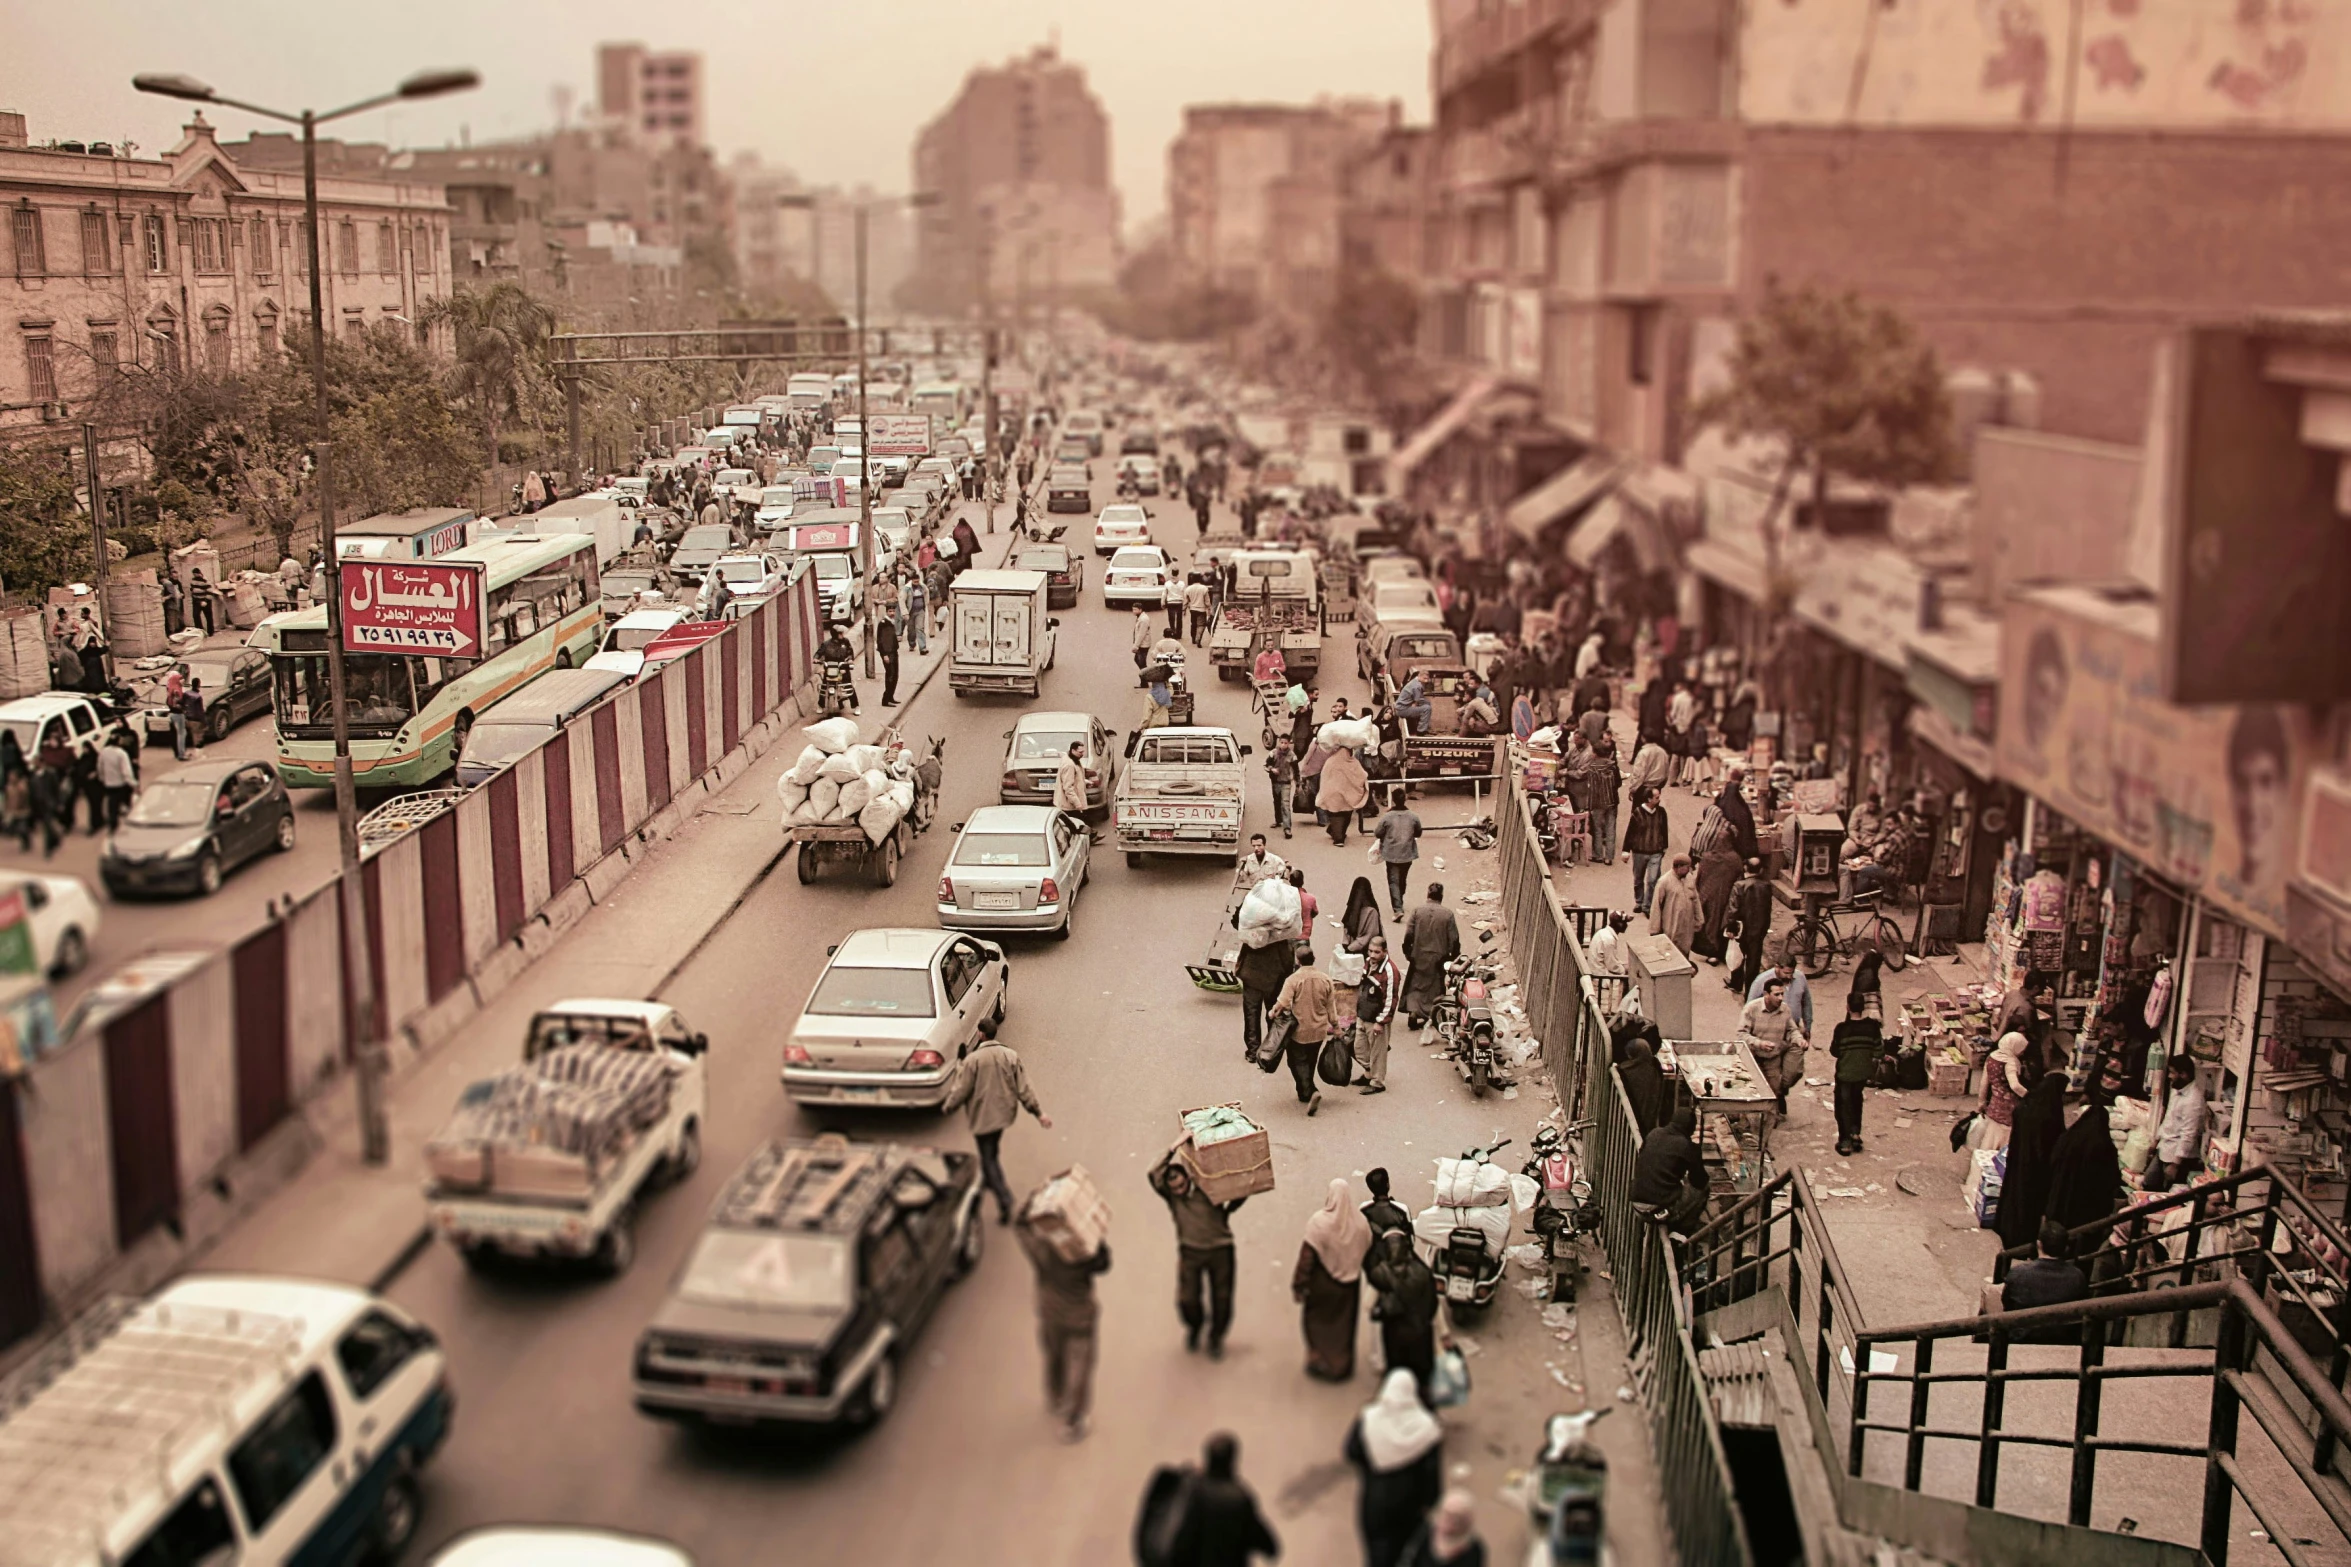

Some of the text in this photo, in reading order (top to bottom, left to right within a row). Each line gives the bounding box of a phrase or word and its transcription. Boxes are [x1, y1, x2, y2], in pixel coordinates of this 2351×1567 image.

[430, 524, 462, 556] LORD
[392, 569, 430, 584] شركة
[350, 566, 471, 611] العسال
[414, 610, 455, 626] للملابس
[1421, 750, 1479, 758] SUZUKI
[1139, 807, 1216, 819] NISSAN
